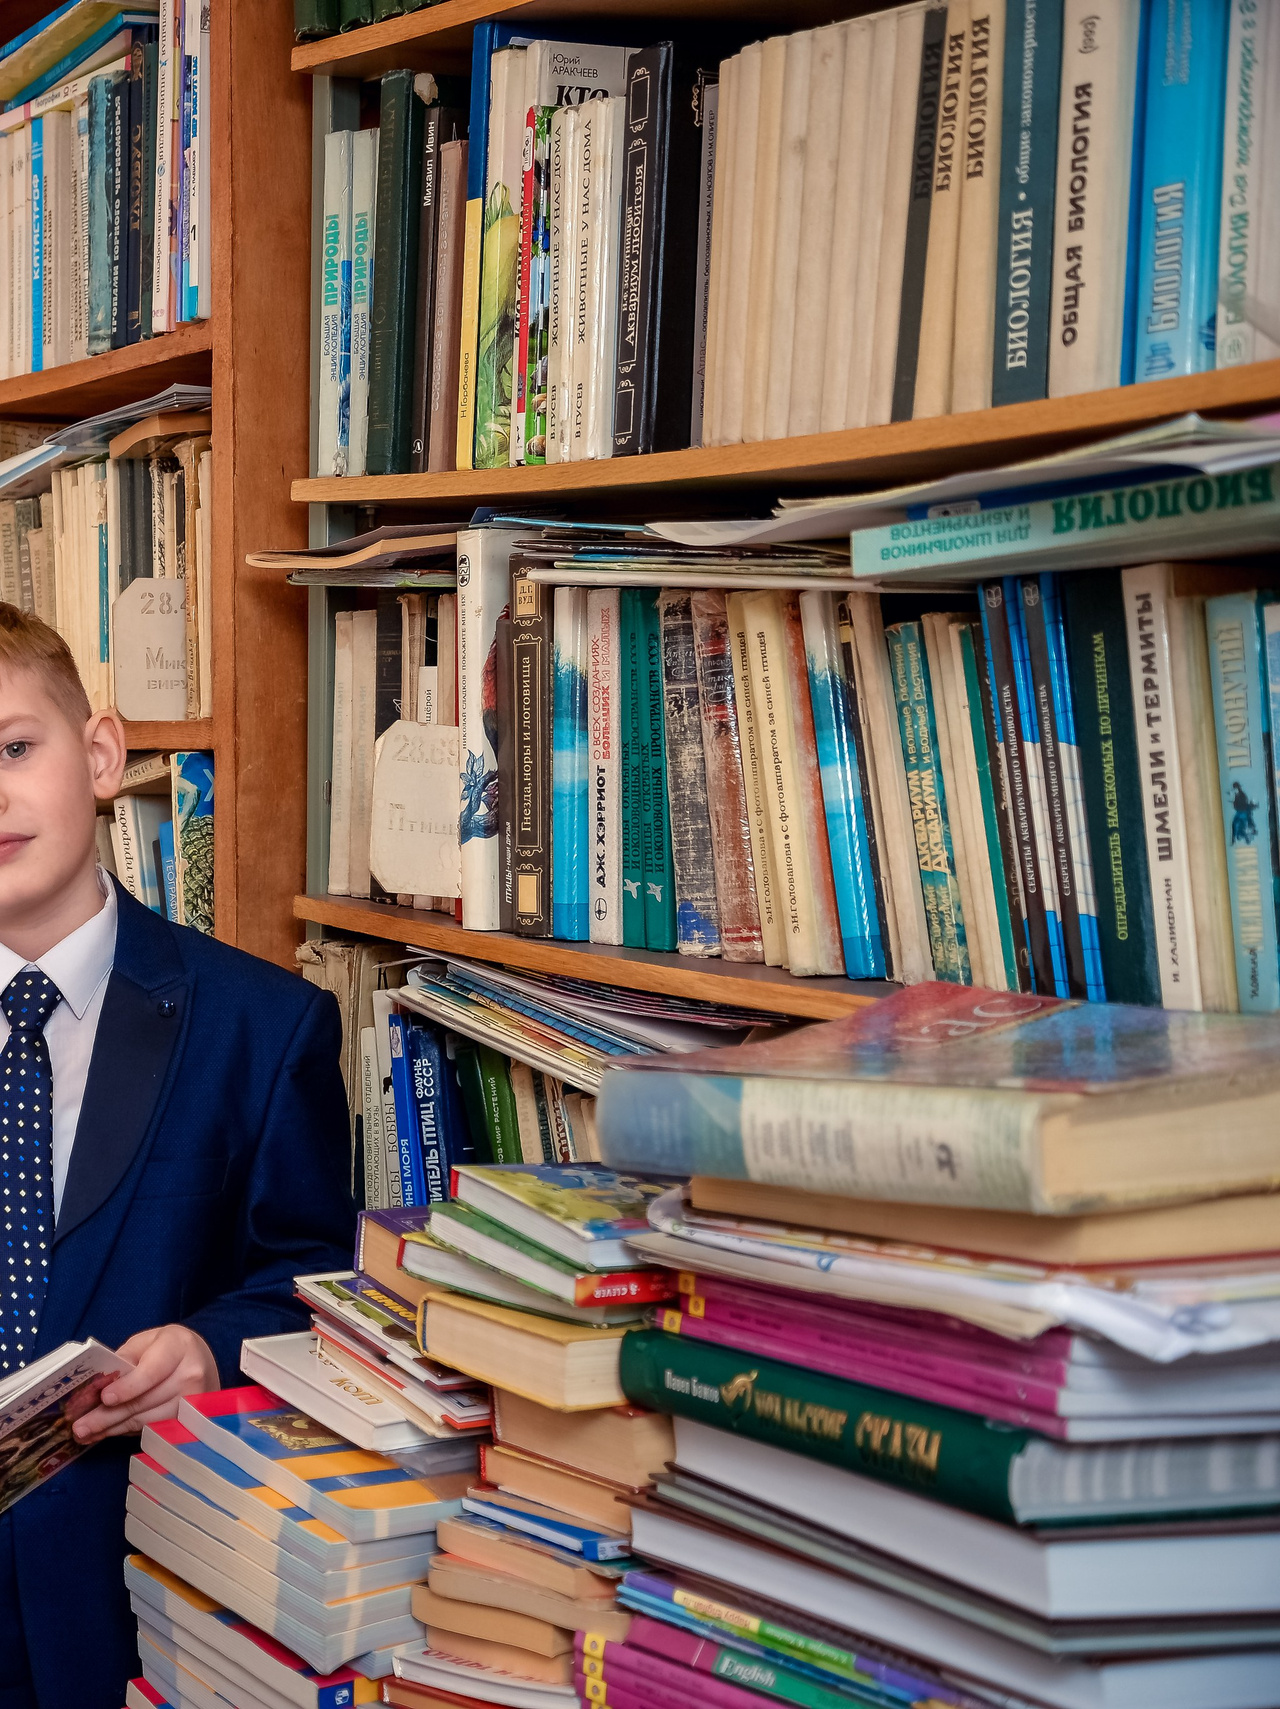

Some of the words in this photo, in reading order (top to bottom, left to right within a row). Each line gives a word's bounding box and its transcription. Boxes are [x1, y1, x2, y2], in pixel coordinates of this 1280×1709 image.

[552, 53, 581, 66] Юрий
[552, 66, 599, 79] АРАКЧЕЕВ
[34, 91, 61, 109] География
[158, 69, 167, 161] ЭНЦИКЛОПЕДИЯ
[555, 85, 609, 107] КТО
[914, 41, 940, 200] БИОЛОГИЯ
[934, 30, 965, 193] БИОЛОГИЯ
[966, 14, 990, 180] БИОЛОГИЯ
[426, 121, 435, 154] Ивин
[554, 125, 562, 178] ДОМА
[582, 119, 592, 173] ДОМА
[1016, 131, 1033, 184] общие
[1067, 82, 1093, 233] БИОЛОГИЯ
[129, 124, 141, 231] ГЛОБУС
[423, 160, 433, 207] Михаил
[581, 177, 590, 215] НАС
[32, 173, 41, 281] КАТАСТРОФ
[554, 224, 561, 236] У
[581, 221, 589, 232] У
[630, 164, 644, 254] любителя
[324, 213, 340, 306] ПРИРОДЫ
[354, 212, 369, 304] ПРИРОДЫ
[623, 206, 634, 289] ЗОЛОТНИЦКИЙ
[703, 210, 712, 277] беспозвоночных
[111, 265, 119, 334] ТРОПАМИ
[552, 242, 560, 347] ЖИВОТНЫЕ
[578, 238, 589, 344] ЖИВОТНЫЕ
[625, 259, 640, 346] Аквариум
[701, 279, 709, 332] определитель
[1005, 207, 1034, 371] БИОЛОГИЯ
[1061, 245, 1086, 347] ОБЩАЯ
[330, 314, 338, 382] ЭНЦИКЛОПЕДИЯ
[359, 313, 367, 381] ЭНЦИКЛОПЕДИЯ
[697, 341, 706, 376] Атлас
[575, 382, 583, 439] В.ГУСЕВ
[889, 509, 1016, 541] АБИТУРИЕНТОВ
[1052, 467, 1273, 535] БИОЛОГИЯ
[2, 523, 14, 579] ПРИРОДЫ
[880, 528, 992, 561] ШКОЛЬНИКОВ
[996, 523, 1031, 542] ДЛЯ
[518, 596, 534, 604] ВУД
[519, 585, 533, 594] Д.Г.
[600, 608, 610, 666] МАЛЫХ
[648, 632, 660, 666] СССР
[736, 631, 749, 672] птицей
[756, 631, 769, 672] птицей
[1135, 591, 1161, 728] ТЕРМИТЫ
[521, 656, 532, 729] логовища
[601, 670, 610, 681] И
[741, 674, 752, 708] синей
[761, 675, 773, 710] синей
[894, 642, 910, 701] РАСТЕНИЯ
[907, 642, 923, 701] РАСТЕНИЯ
[1092, 631, 1110, 714] ЛИЧИНКАМ
[1212, 621, 1252, 771] ПАФНУТИЙ
[522, 732, 531, 741] и
[592, 717, 601, 745] ВСЕХ
[601, 685, 611, 760] БОЛЬШИХ
[630, 667, 640, 755] ПРОСТРАНСТВ
[649, 669, 662, 757] ПРОСТРАНСТВ
[745, 710, 753, 723] за
[767, 712, 776, 726] за
[1002, 685, 1019, 757] РЫБОВОДСТВА
[1037, 684, 1055, 758] РЫБОВОДСТВА
[1099, 715, 1111, 735] ПО
[522, 745, 533, 781] норы
[593, 749, 601, 760] О
[622, 741, 630, 809] ОТКРЫТЫХ
[641, 742, 651, 812] ОТКРЫТЫХ
[746, 726, 765, 817] фотоаппаратом
[769, 729, 790, 822] фотоаппаратом
[596, 764, 607, 847] ХЭРРИОТ
[631, 765, 641, 858] ОКОЛОВОДНЫХ
[1012, 760, 1030, 842] АКВАРИУМНОГО
[1048, 761, 1065, 845] АКВАРИУМНОГО
[1102, 740, 1120, 828] НАСЕКОМЫХ
[1150, 750, 1172, 862] ШМЕЛИ
[118, 804, 135, 871] природы
[652, 767, 665, 860] ОКОЛОВОДНЫХ
[907, 768, 933, 872] АКВАРИУМ
[921, 768, 950, 874] АКВАРИУМ
[596, 849, 607, 888] ДЖ.
[622, 820, 630, 870] ПТИЦЫ
[643, 822, 653, 873] ПТИЦЫ
[655, 862, 664, 873] И
[1023, 846, 1037, 893] СЕКРЕТЫ
[1058, 849, 1072, 897] СЕКРЕТЫ
[926, 884, 941, 937] ЦИРЛИНГ
[939, 885, 955, 939] ЦИРЛИНГ
[1109, 833, 1128, 940] ОПРЕДЕЛИТЕЛЬ
[1164, 878, 1180, 966] ХАЛИФМАН
[363, 1054, 372, 1104] ОТДЕЛЕНИЙ
[422, 1057, 435, 1097] СССР
[488, 1077, 500, 1123] РАСТЕНИЙ
[366, 1107, 374, 1193] ПОДГОТОВИТЕЛЬНЫХ
[384, 1101, 398, 1153] БОБРЫ
[420, 1101, 437, 1146] ПТИЦ
[494, 1126, 502, 1144] МИР
[373, 1137, 381, 1202] ПОСТУПАЮЩИХ
[400, 1138, 412, 1177] МОРЯ
[593, 1287, 628, 1299] CLEVER
[665, 1368, 691, 1395] Павел
[691, 1376, 720, 1404] Бажов
[725, 1609, 751, 1629] Happy
[719, 1655, 776, 1688] English
